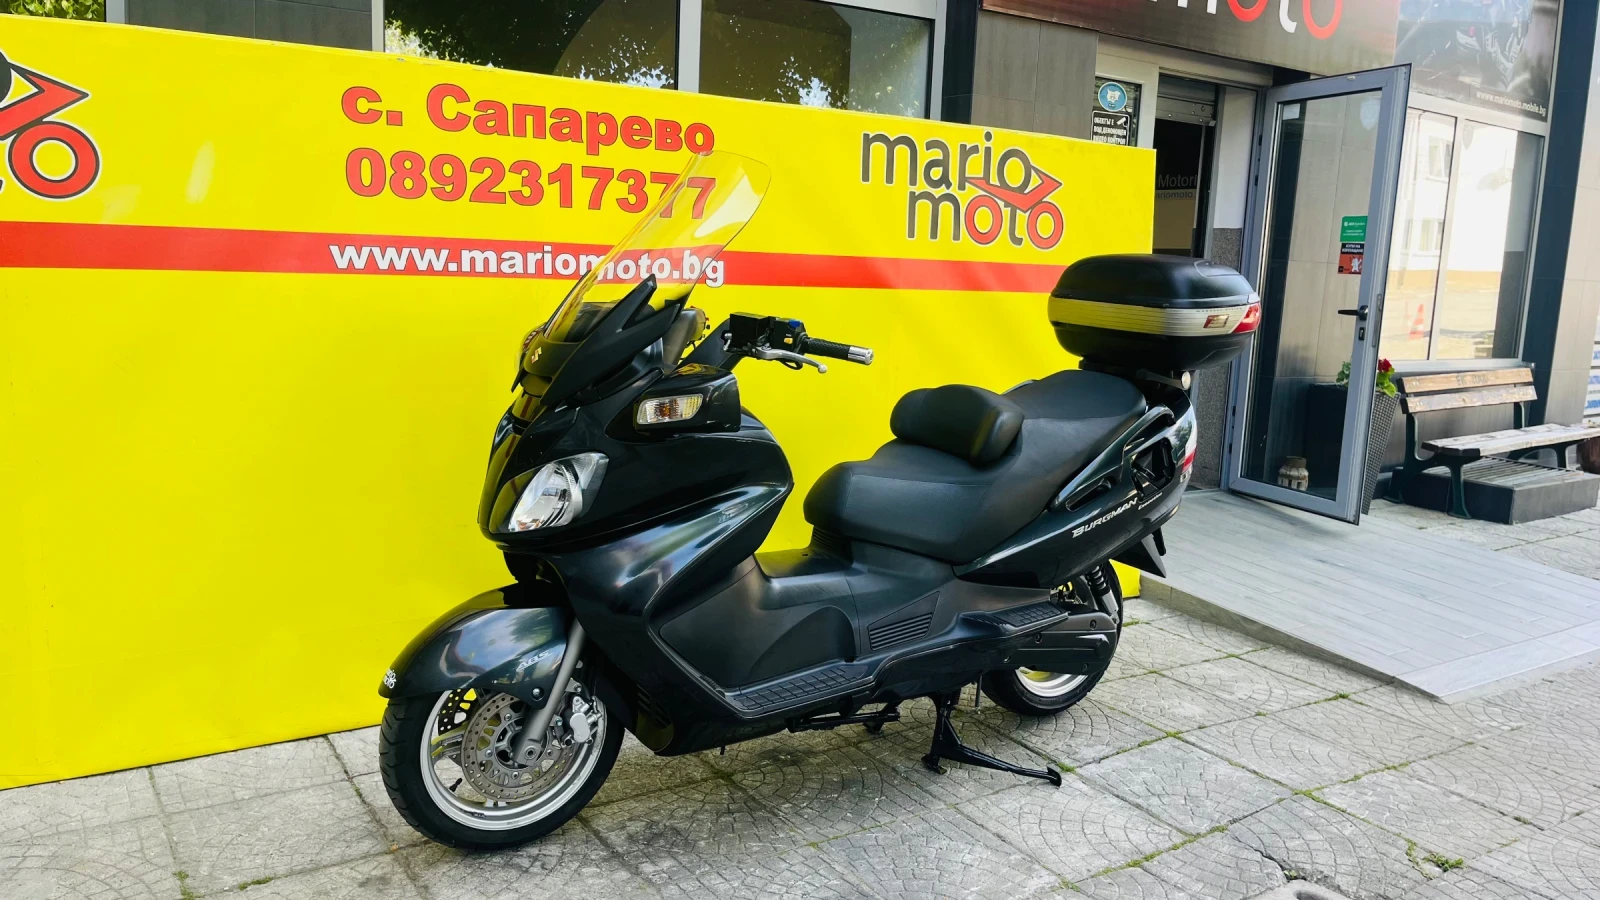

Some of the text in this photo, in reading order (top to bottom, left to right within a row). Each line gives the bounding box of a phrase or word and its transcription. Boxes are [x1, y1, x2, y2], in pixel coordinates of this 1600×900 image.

[340, 83, 715, 157] с. Сапарево
[1476, 90, 1547, 117] www.mariomoto.mobile.bg
[345, 147, 716, 220] 0892317377
[861, 131, 1032, 194] mario
[907, 190, 1064, 250] moto
[328, 244, 725, 289] www.mariomoto.bg
[1072, 497, 1138, 539] BURGMAN
